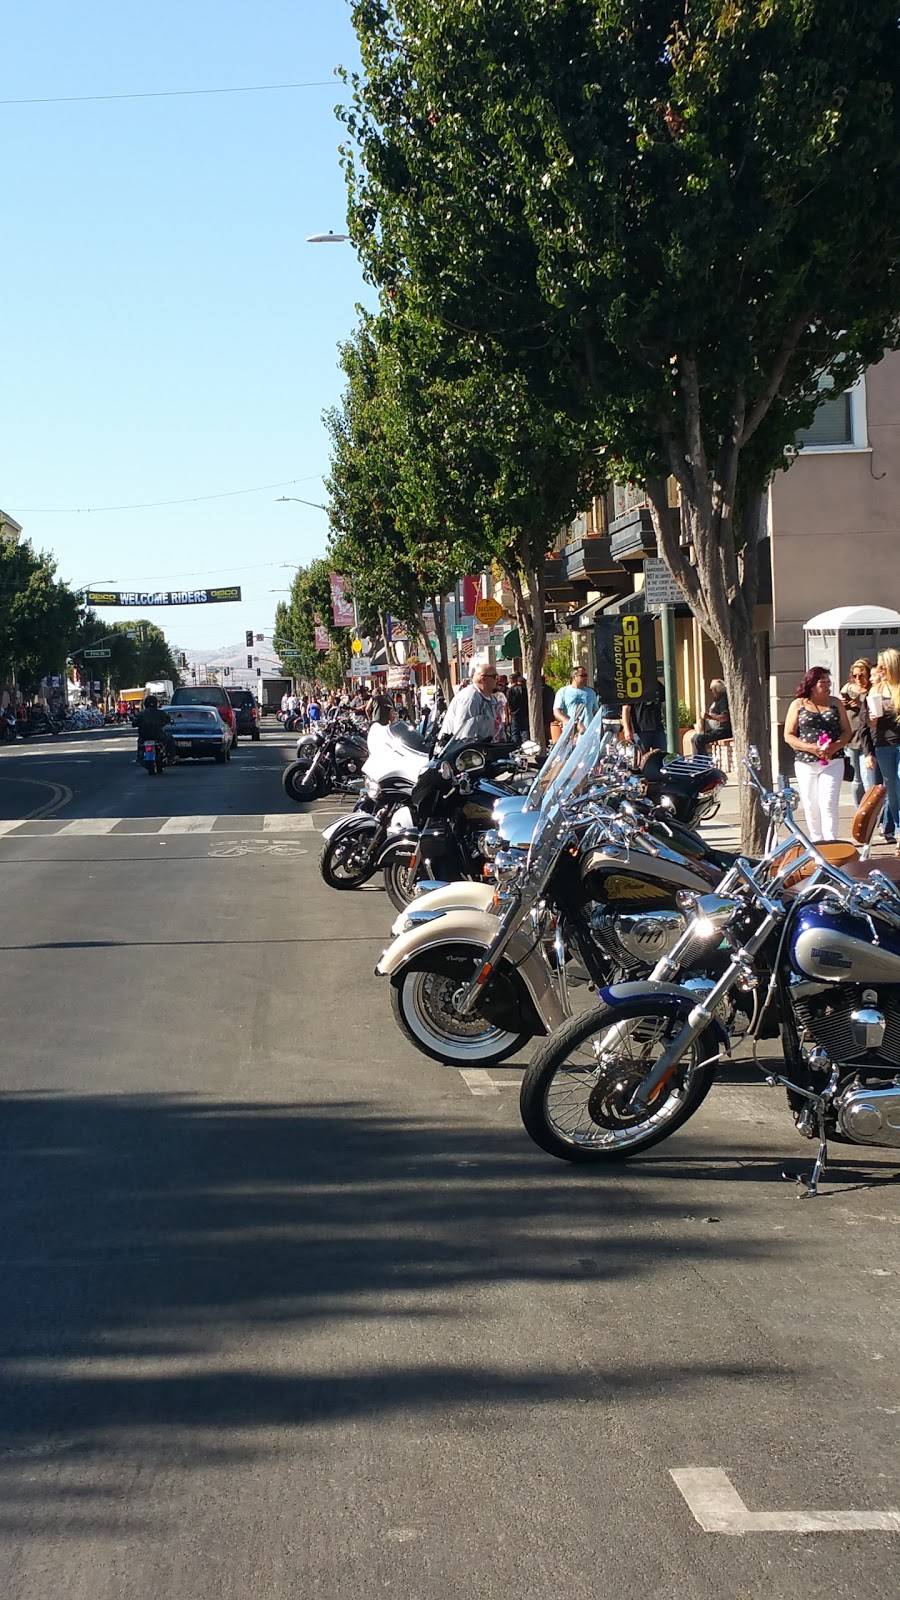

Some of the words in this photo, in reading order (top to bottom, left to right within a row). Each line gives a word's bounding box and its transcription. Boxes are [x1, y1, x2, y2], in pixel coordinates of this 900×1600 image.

[120, 592, 169, 605] WELCOME
[171, 591, 208, 604] RIDERS
[613, 634, 627, 699] Motorcycle
[622, 615, 643, 699] GEICO
